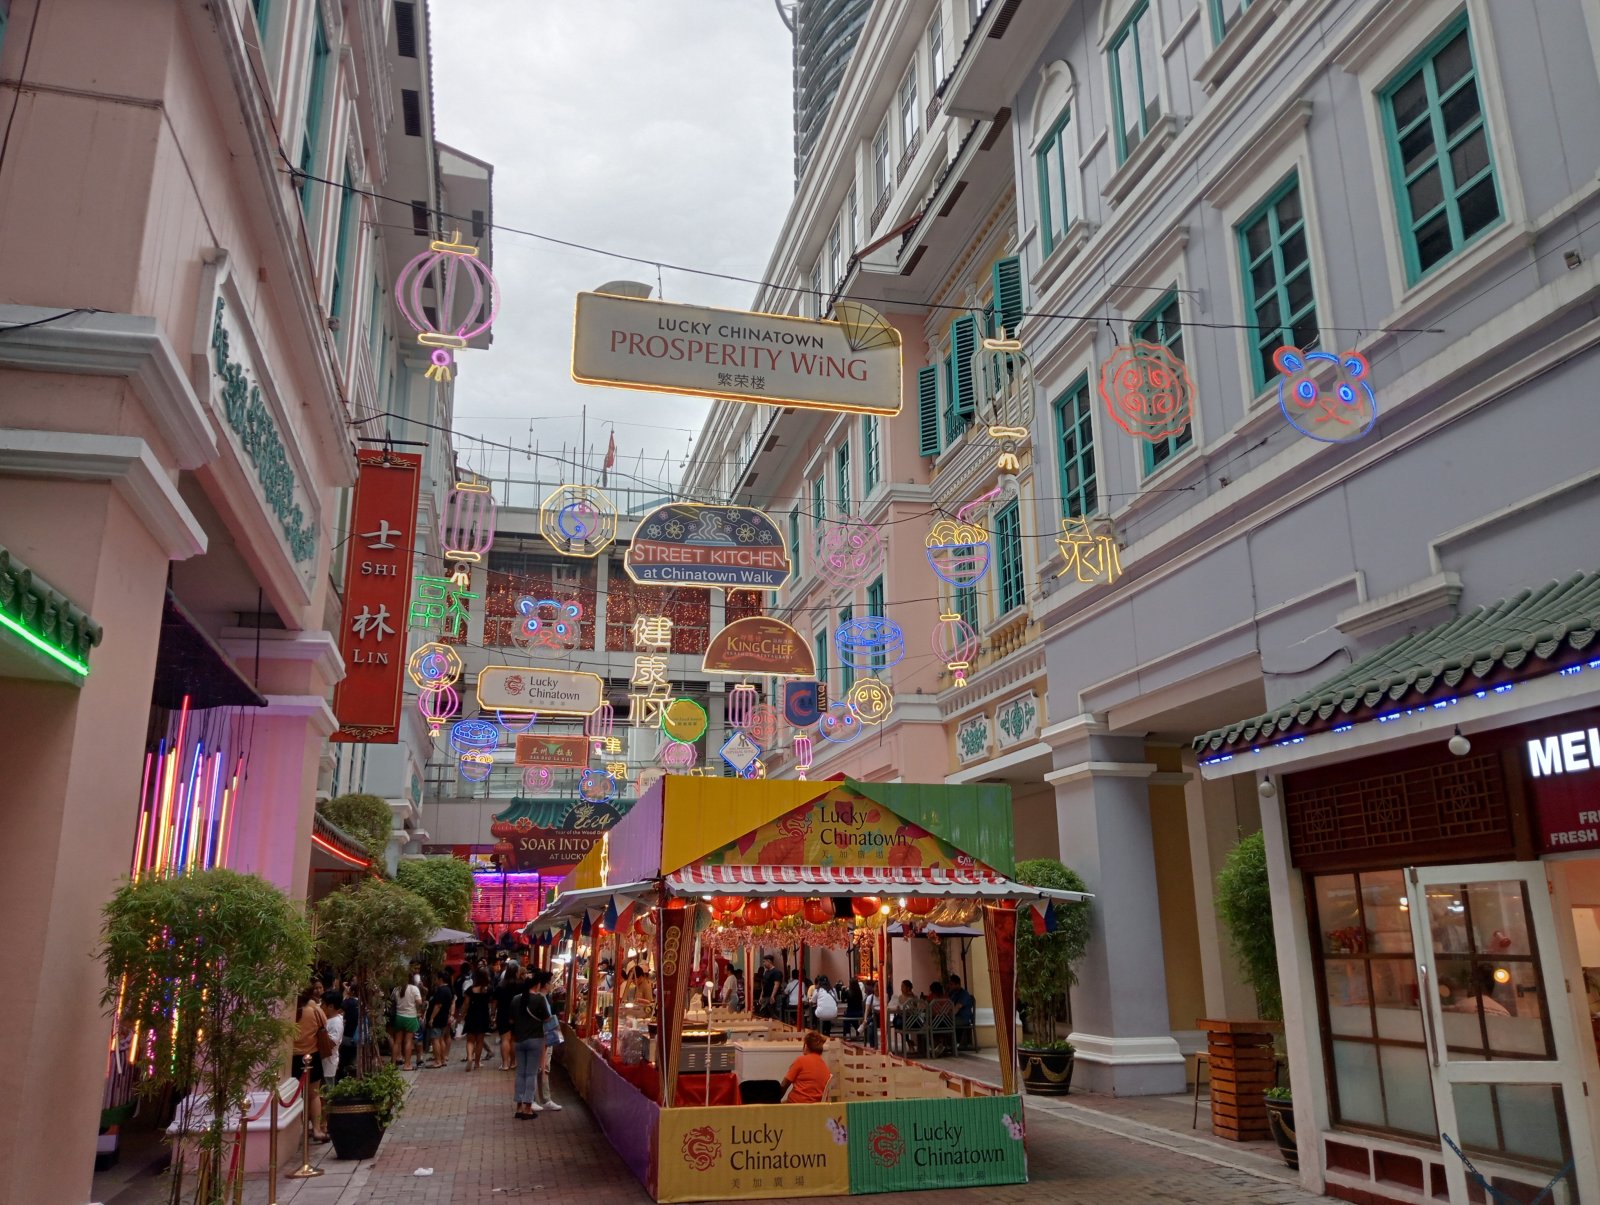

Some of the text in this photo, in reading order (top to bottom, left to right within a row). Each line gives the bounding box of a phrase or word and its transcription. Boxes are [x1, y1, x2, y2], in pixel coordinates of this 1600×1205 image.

[657, 317, 824, 349] LUCKY CHINATOWN
[610, 329, 781, 371] PROSPERITY
[717, 372, 766, 390] 繁荣楼
[361, 519, 402, 549] 士
[634, 543, 786, 567] STREET KITCHEN
[643, 567, 773, 584] at Chinatown Walk
[352, 603, 396, 642] 林
[530, 676, 559, 688] Lucky
[528, 687, 580, 701] Chinatown
[820, 806, 868, 829] Lucky
[519, 837, 556, 851] SOAR
[559, 838, 590, 851] INTO
[820, 828, 907, 847] Chinatown
[1550, 828, 1598, 846] FRESH
[730, 1123, 783, 1150] Lucky
[913, 1121, 963, 1147] Lucky
[730, 1150, 827, 1171] Chinatown
[913, 1146, 1006, 1167] Chinatown
